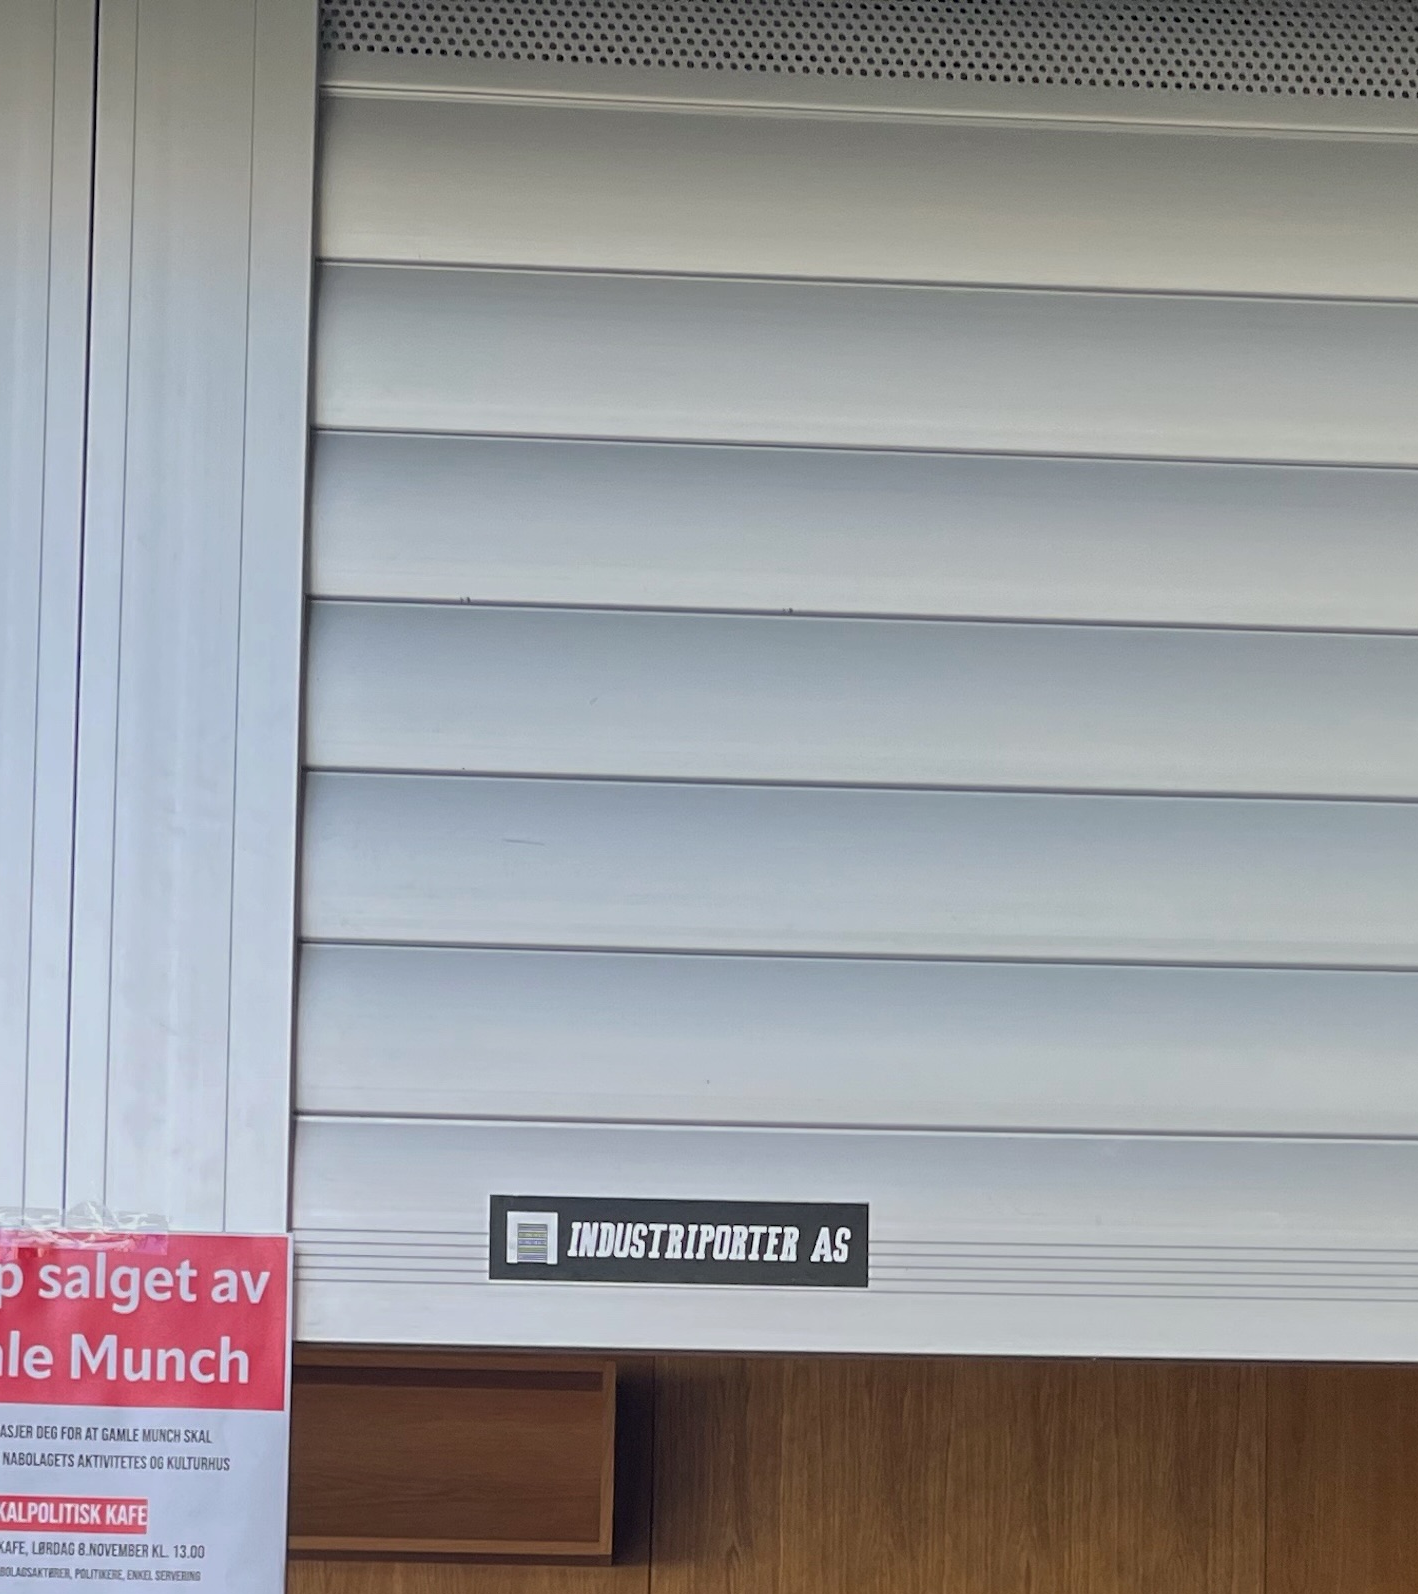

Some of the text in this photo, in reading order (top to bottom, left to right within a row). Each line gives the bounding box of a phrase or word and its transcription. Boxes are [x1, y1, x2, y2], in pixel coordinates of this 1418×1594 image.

[567, 1221, 852, 1262] INDUSTRIPORTER AS
[38, 1252, 197, 1314] salget
[211, 1269, 270, 1304] av
[69, 1334, 249, 1384] Munch
[36, 1425, 58, 1440] DEG
[61, 1426, 82, 1440] FOR
[85, 1427, 99, 1441] AT
[101, 1427, 139, 1442] GAMLE
[142, 1428, 181, 1443] MUNCH
[183, 1429, 213, 1444] SKAL
[2, 1451, 74, 1468] NABOLAGETS
[77, 1453, 147, 1470] AKTIVITETES
[149, 1455, 164, 1470] OG
[166, 1456, 231, 1471] KULTURHUS
[105, 1504, 148, 1526] KAFE
[31, 1540, 75, 1556] LØRDAG
[78, 1542, 149, 1558] 8.NOVEMBER
[151, 1544, 169, 1558] KL.
[173, 1544, 205, 1559] 13.00
